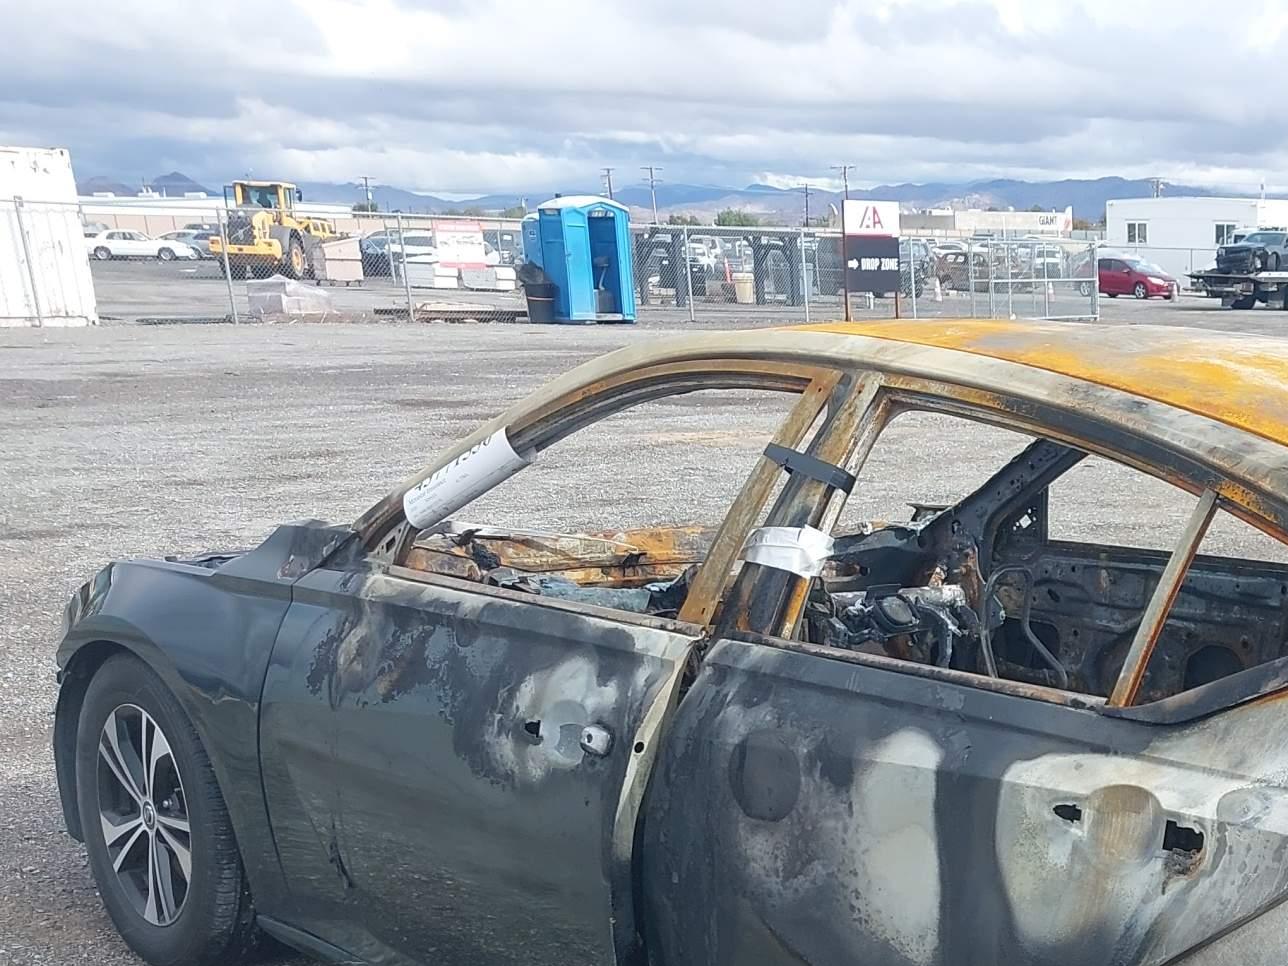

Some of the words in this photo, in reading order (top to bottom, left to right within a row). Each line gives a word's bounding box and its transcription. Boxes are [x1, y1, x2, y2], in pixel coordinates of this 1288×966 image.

[1039, 215, 1057, 226] GIANT
[861, 257, 880, 271] DROP
[881, 257, 899, 271] ZONE
